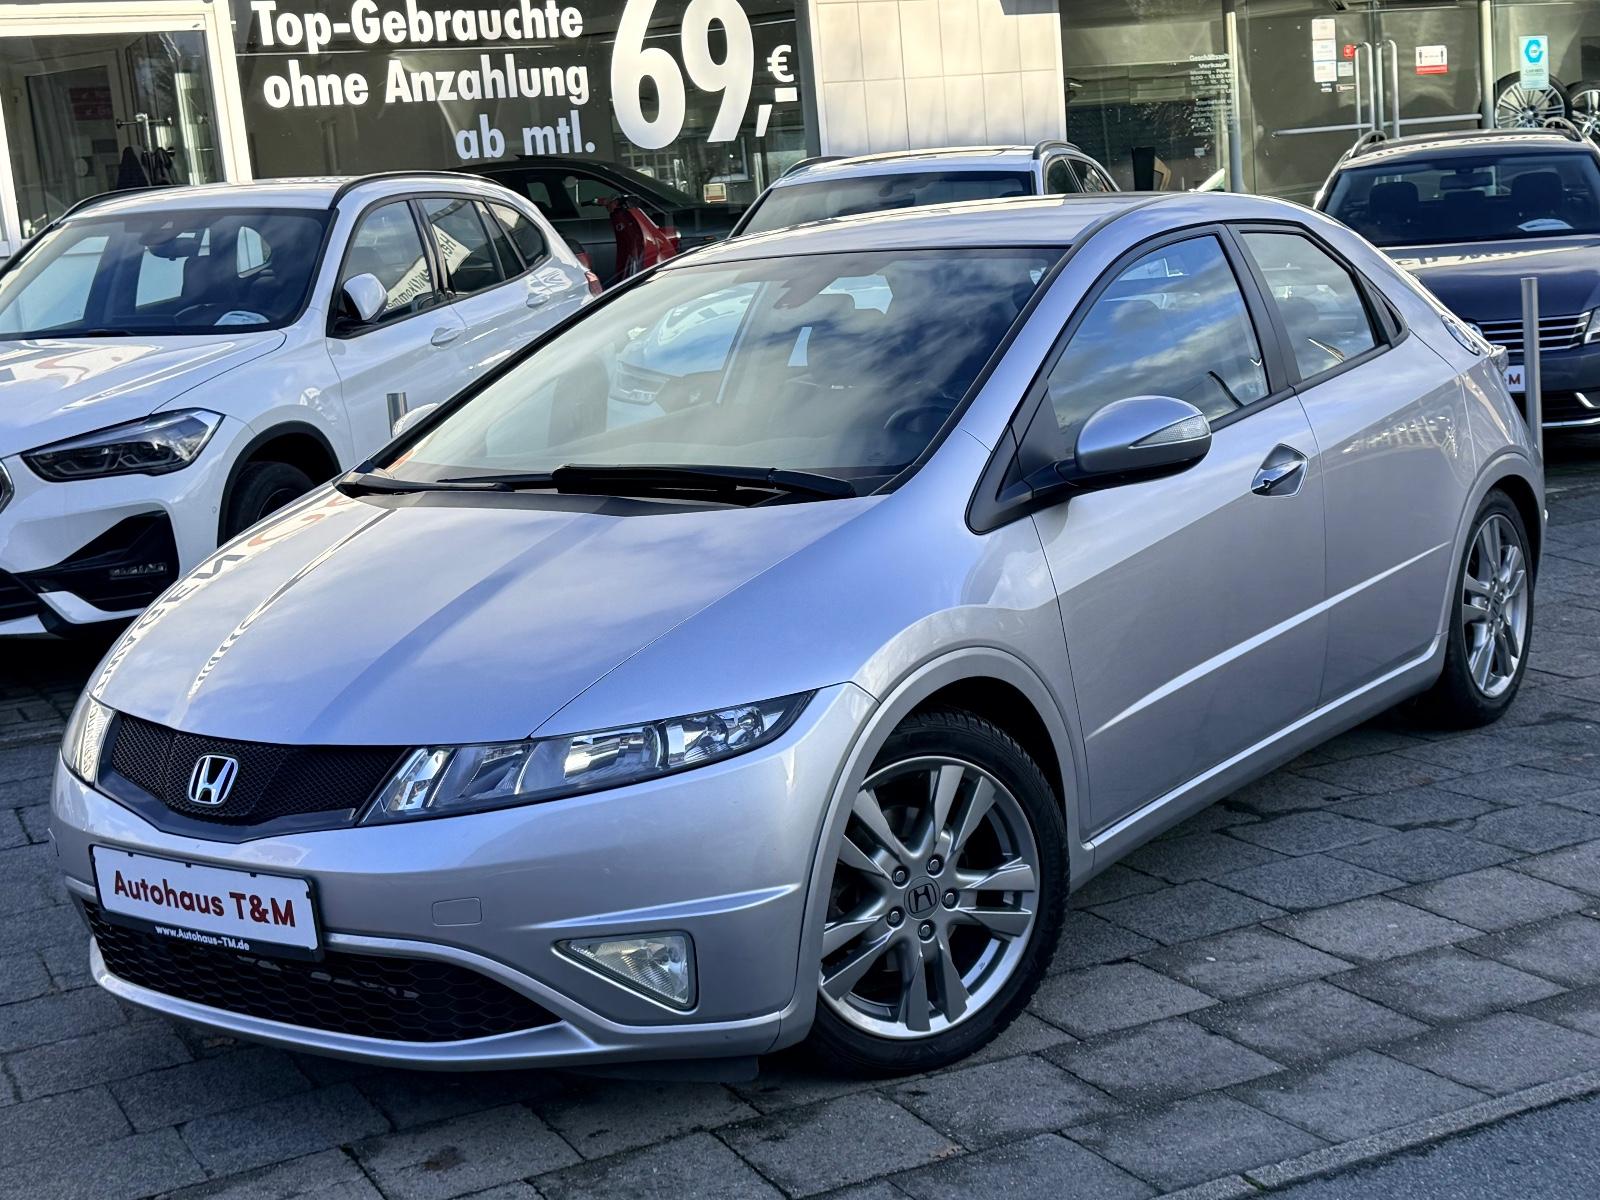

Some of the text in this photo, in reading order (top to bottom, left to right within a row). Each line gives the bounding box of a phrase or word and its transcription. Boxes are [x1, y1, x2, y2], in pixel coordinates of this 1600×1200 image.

[251, 0, 584, 54] Top-Gebrauchte
[263, 53, 590, 108] ohne Anzahlung
[455, 110, 597, 160] ab mtl.
[1506, 373, 1521, 385] M
[114, 869, 296, 928] Autohaus T&M
[154, 925, 251, 951] www.Autohaus-TM.de
